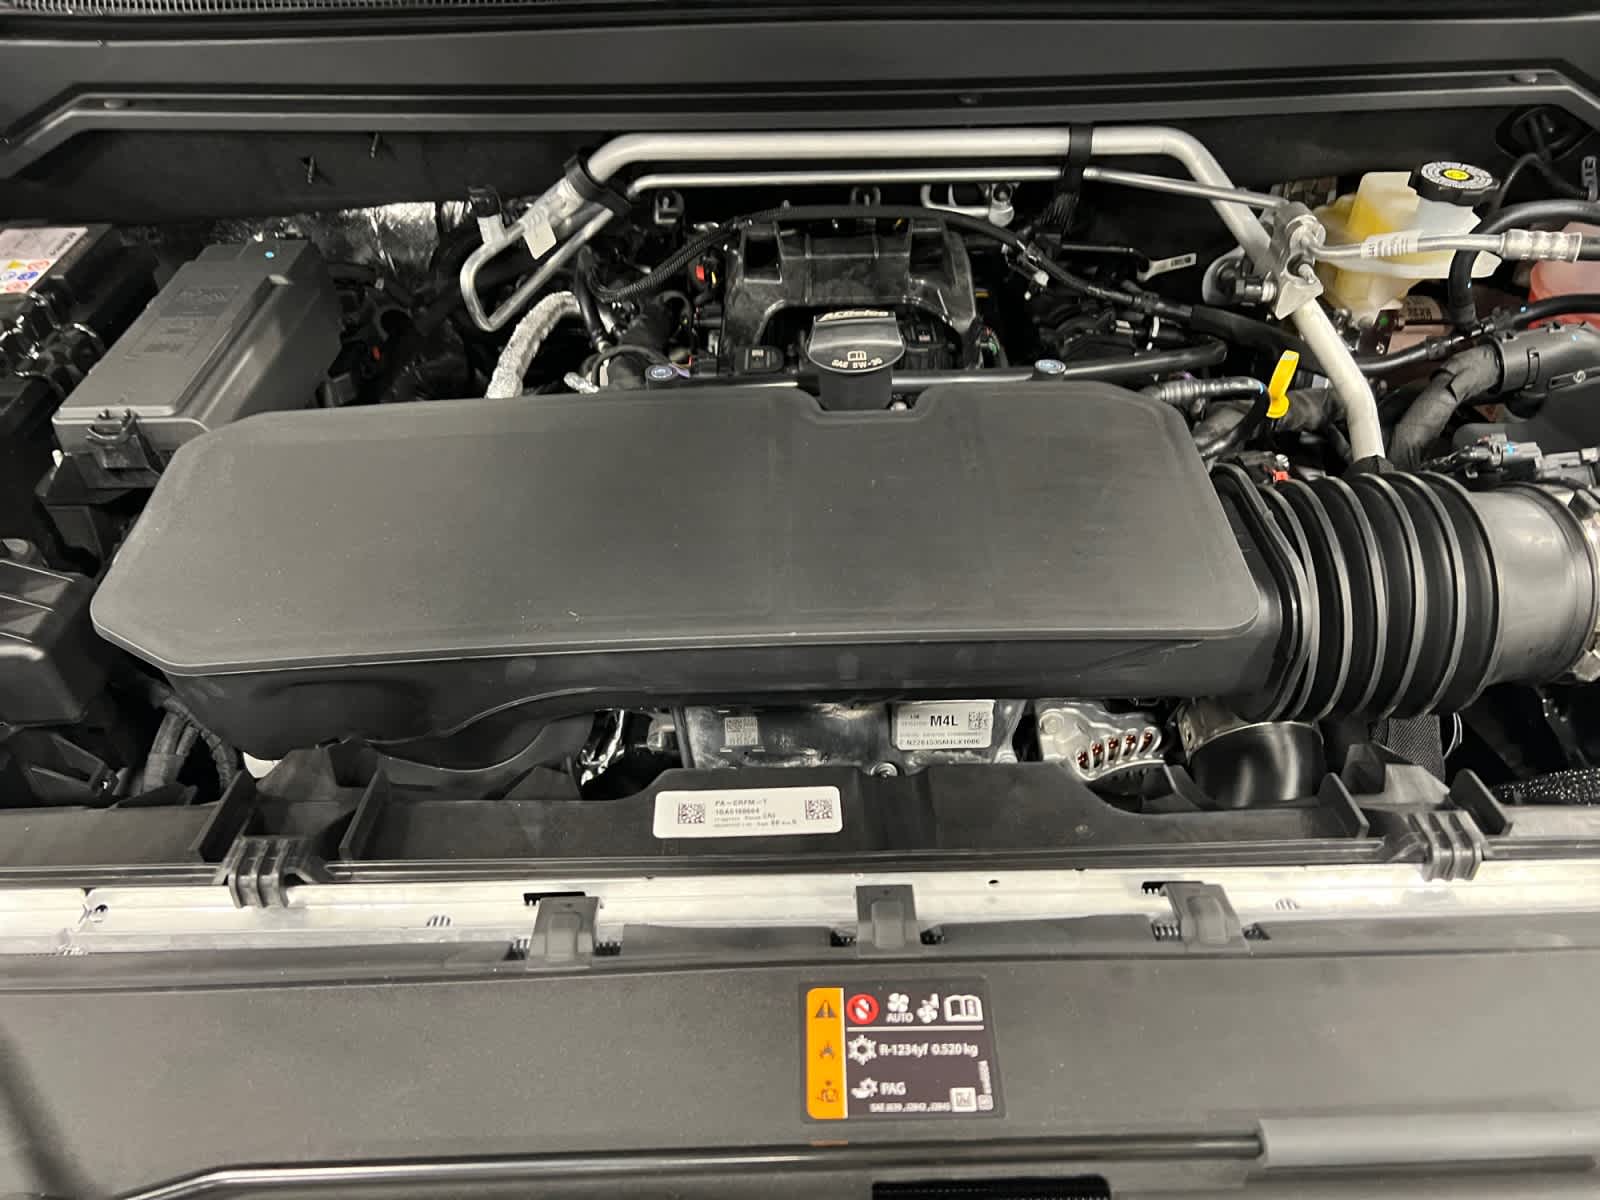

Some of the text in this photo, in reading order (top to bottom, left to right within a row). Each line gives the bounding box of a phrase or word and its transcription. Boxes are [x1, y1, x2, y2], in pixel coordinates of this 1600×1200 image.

[930, 715, 958, 727] M4L
[886, 1013, 914, 1023] AUTO
[879, 1043, 928, 1058] R-1234yf
[963, 1042, 978, 1058] kg
[879, 1081, 906, 1096] PAG
